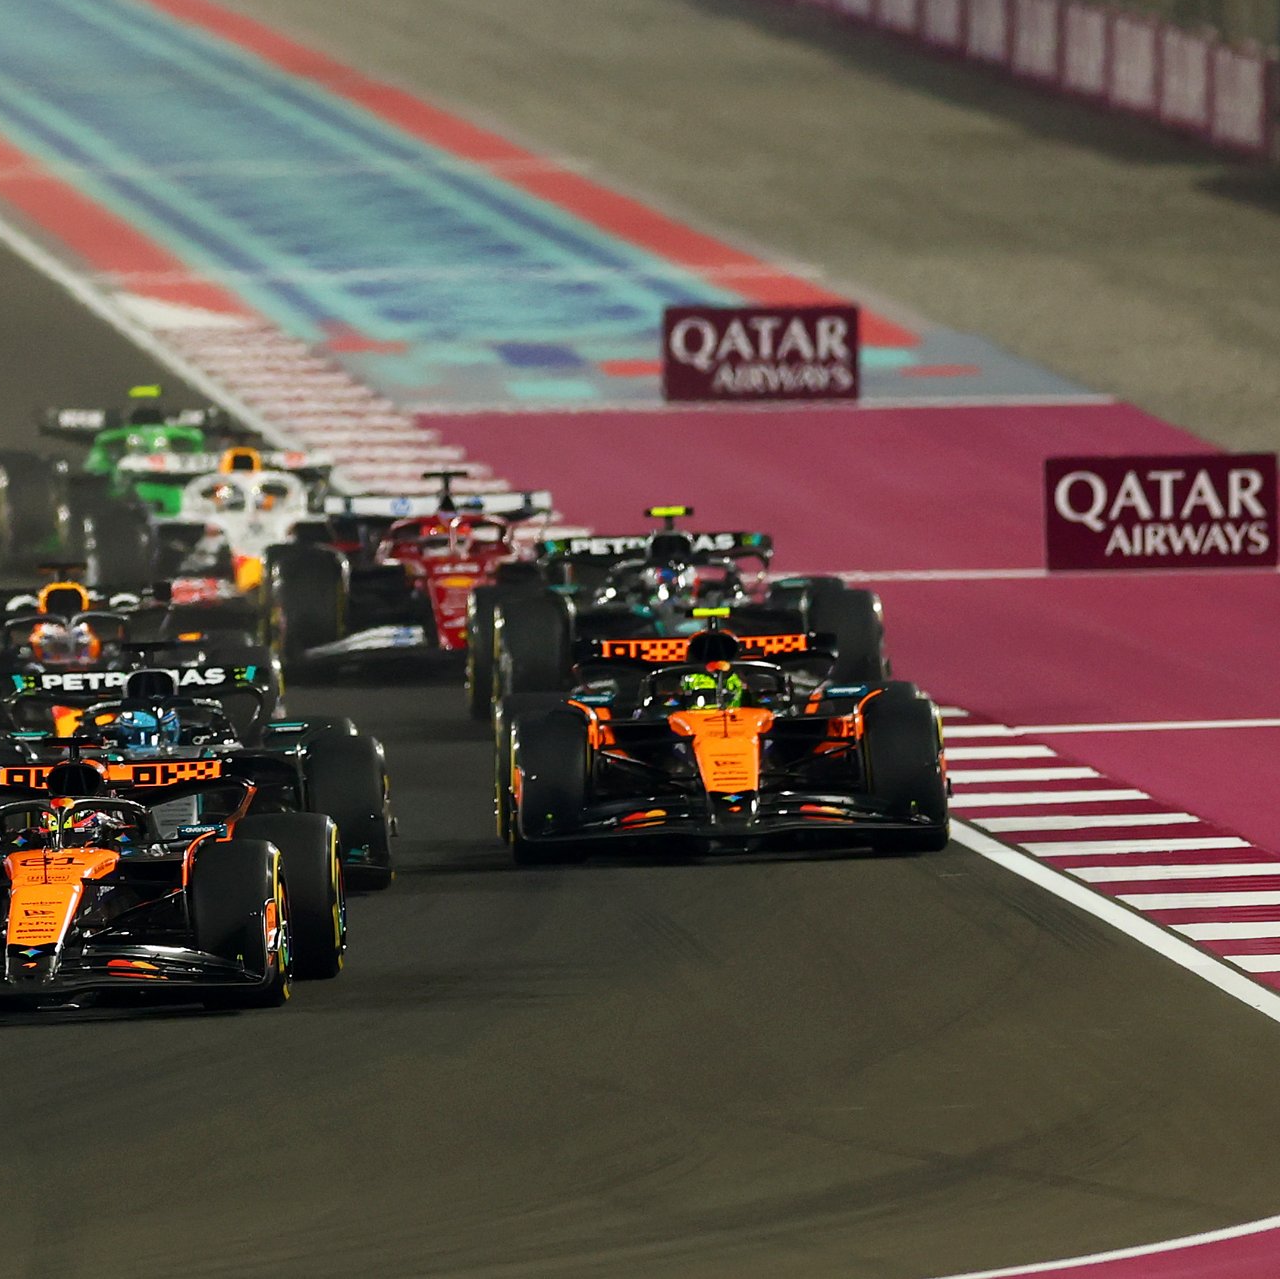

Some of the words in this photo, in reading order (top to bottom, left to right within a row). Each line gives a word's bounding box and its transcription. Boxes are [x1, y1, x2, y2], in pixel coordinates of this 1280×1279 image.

[670, 317, 849, 372] QATAR
[713, 361, 854, 393] AIRWAYS
[1054, 468, 1266, 533] QATAR
[1106, 519, 1271, 557] AIRWAYS
[41, 667, 226, 691] PETRAS
